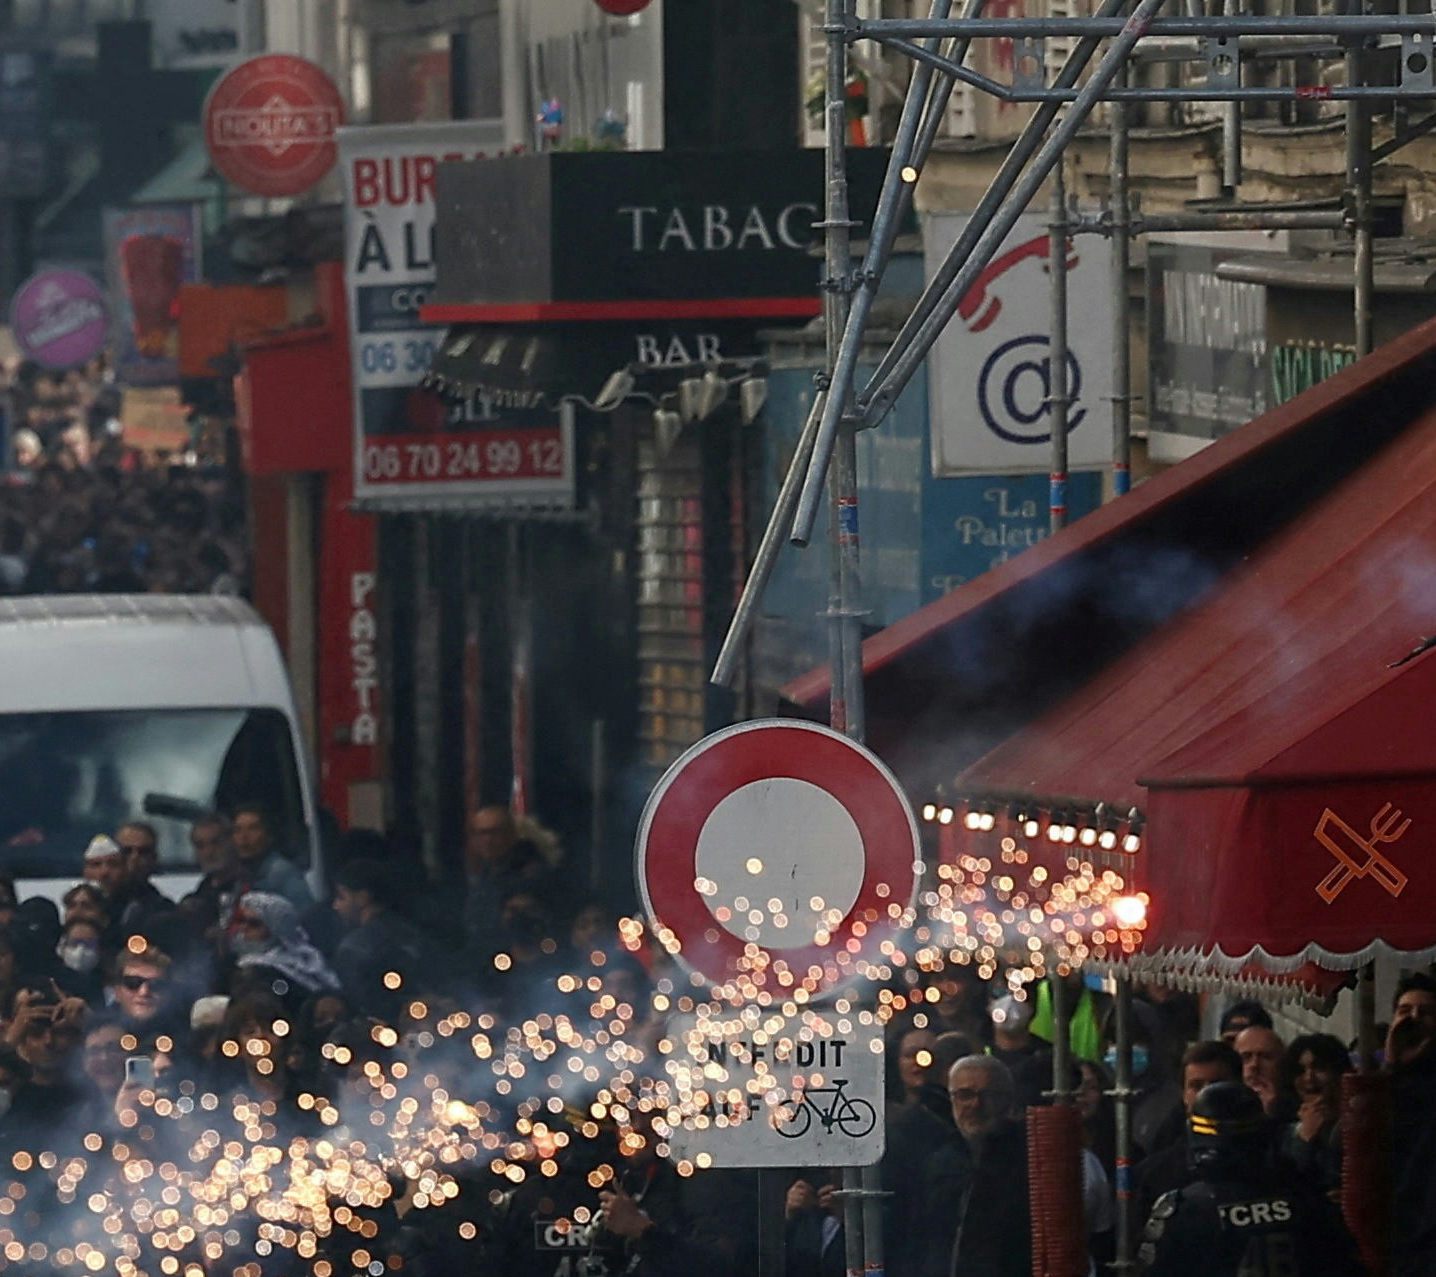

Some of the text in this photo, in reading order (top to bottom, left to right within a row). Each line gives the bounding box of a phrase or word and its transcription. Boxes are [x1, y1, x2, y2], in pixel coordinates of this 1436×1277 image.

[617, 202, 819, 251] TABAC
[635, 333, 724, 366] BAR
[1229, 1199, 1292, 1228] CRS
